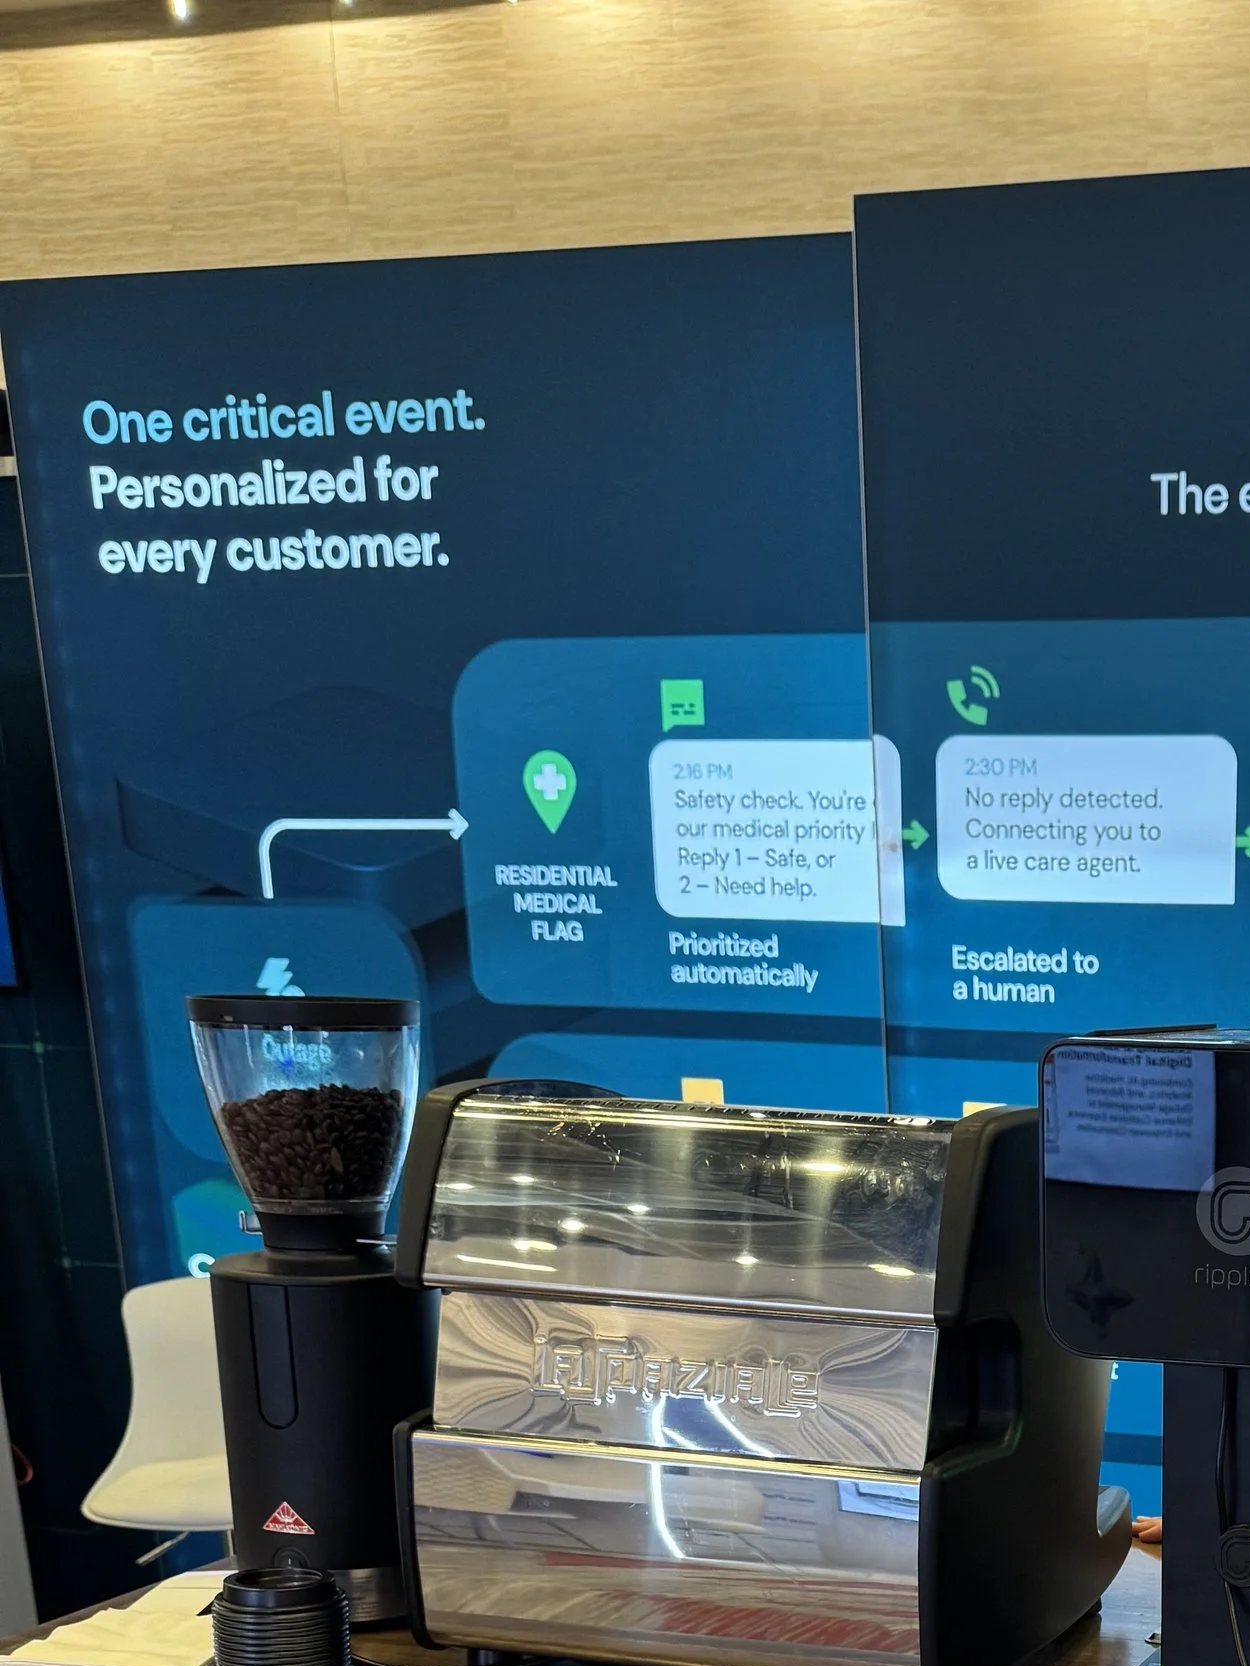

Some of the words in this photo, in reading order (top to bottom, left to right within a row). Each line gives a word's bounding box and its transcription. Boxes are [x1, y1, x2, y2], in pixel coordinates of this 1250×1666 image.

[83, 400, 173, 445] One
[183, 390, 335, 441] critical
[346, 389, 486, 435] event.
[89, 455, 366, 509] Personalized
[374, 455, 439, 501] for
[1151, 471, 1230, 516] The
[98, 538, 217, 584] every
[226, 529, 450, 571] customer.
[707, 763, 733, 780] PM
[964, 758, 1004, 776] 2:30
[1009, 758, 1037, 776] PM
[675, 790, 735, 813] Safety
[740, 790, 803, 810] check.
[808, 790, 866, 810] You're
[965, 787, 994, 808] No
[1001, 788, 1053, 814] reply
[1059, 788, 1164, 809] detected.
[676, 822, 706, 838] our
[713, 820, 789, 838] medical
[795, 821, 866, 844] priority
[965, 818, 1087, 846] Connecting
[1093, 824, 1132, 846] you
[1139, 822, 1161, 841] to
[678, 848, 730, 871] Reply
[735, 849, 742, 867] 1
[765, 848, 811, 870] Safe,
[816, 854, 836, 868] or
[967, 855, 978, 870] a
[984, 849, 1018, 871] live
[1024, 855, 1070, 872] care
[1077, 854, 1141, 878] agent.
[495, 864, 618, 887] RESIDENTIAL
[680, 876, 692, 894] 2
[715, 876, 765, 895] Need
[771, 877, 817, 902] help.
[513, 892, 603, 914] MEDICAL
[531, 920, 584, 941] FLAG
[668, 931, 779, 958] Prioritized
[951, 944, 1068, 974] Escalated
[1072, 950, 1100, 974] to
[671, 962, 819, 993] automatically
[952, 980, 968, 1000] a
[973, 975, 1055, 1004] human
